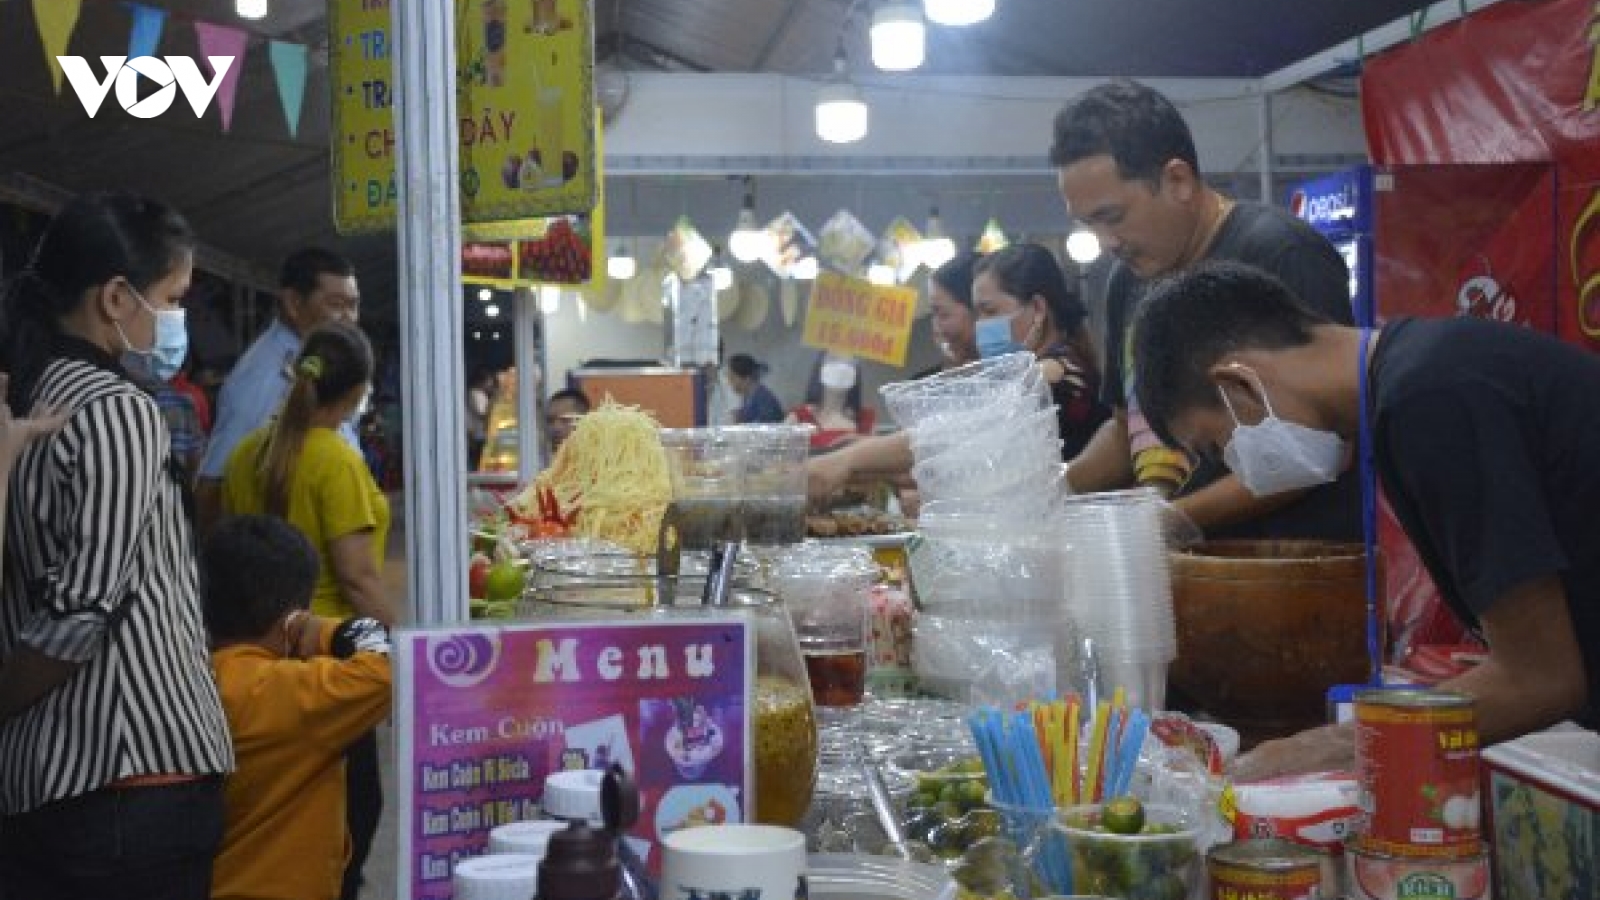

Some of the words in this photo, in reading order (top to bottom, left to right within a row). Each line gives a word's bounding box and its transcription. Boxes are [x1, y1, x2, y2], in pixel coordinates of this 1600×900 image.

[360, 31, 393, 60] TR
[533, 638, 716, 683] Menu
[431, 723, 489, 746] Kem
